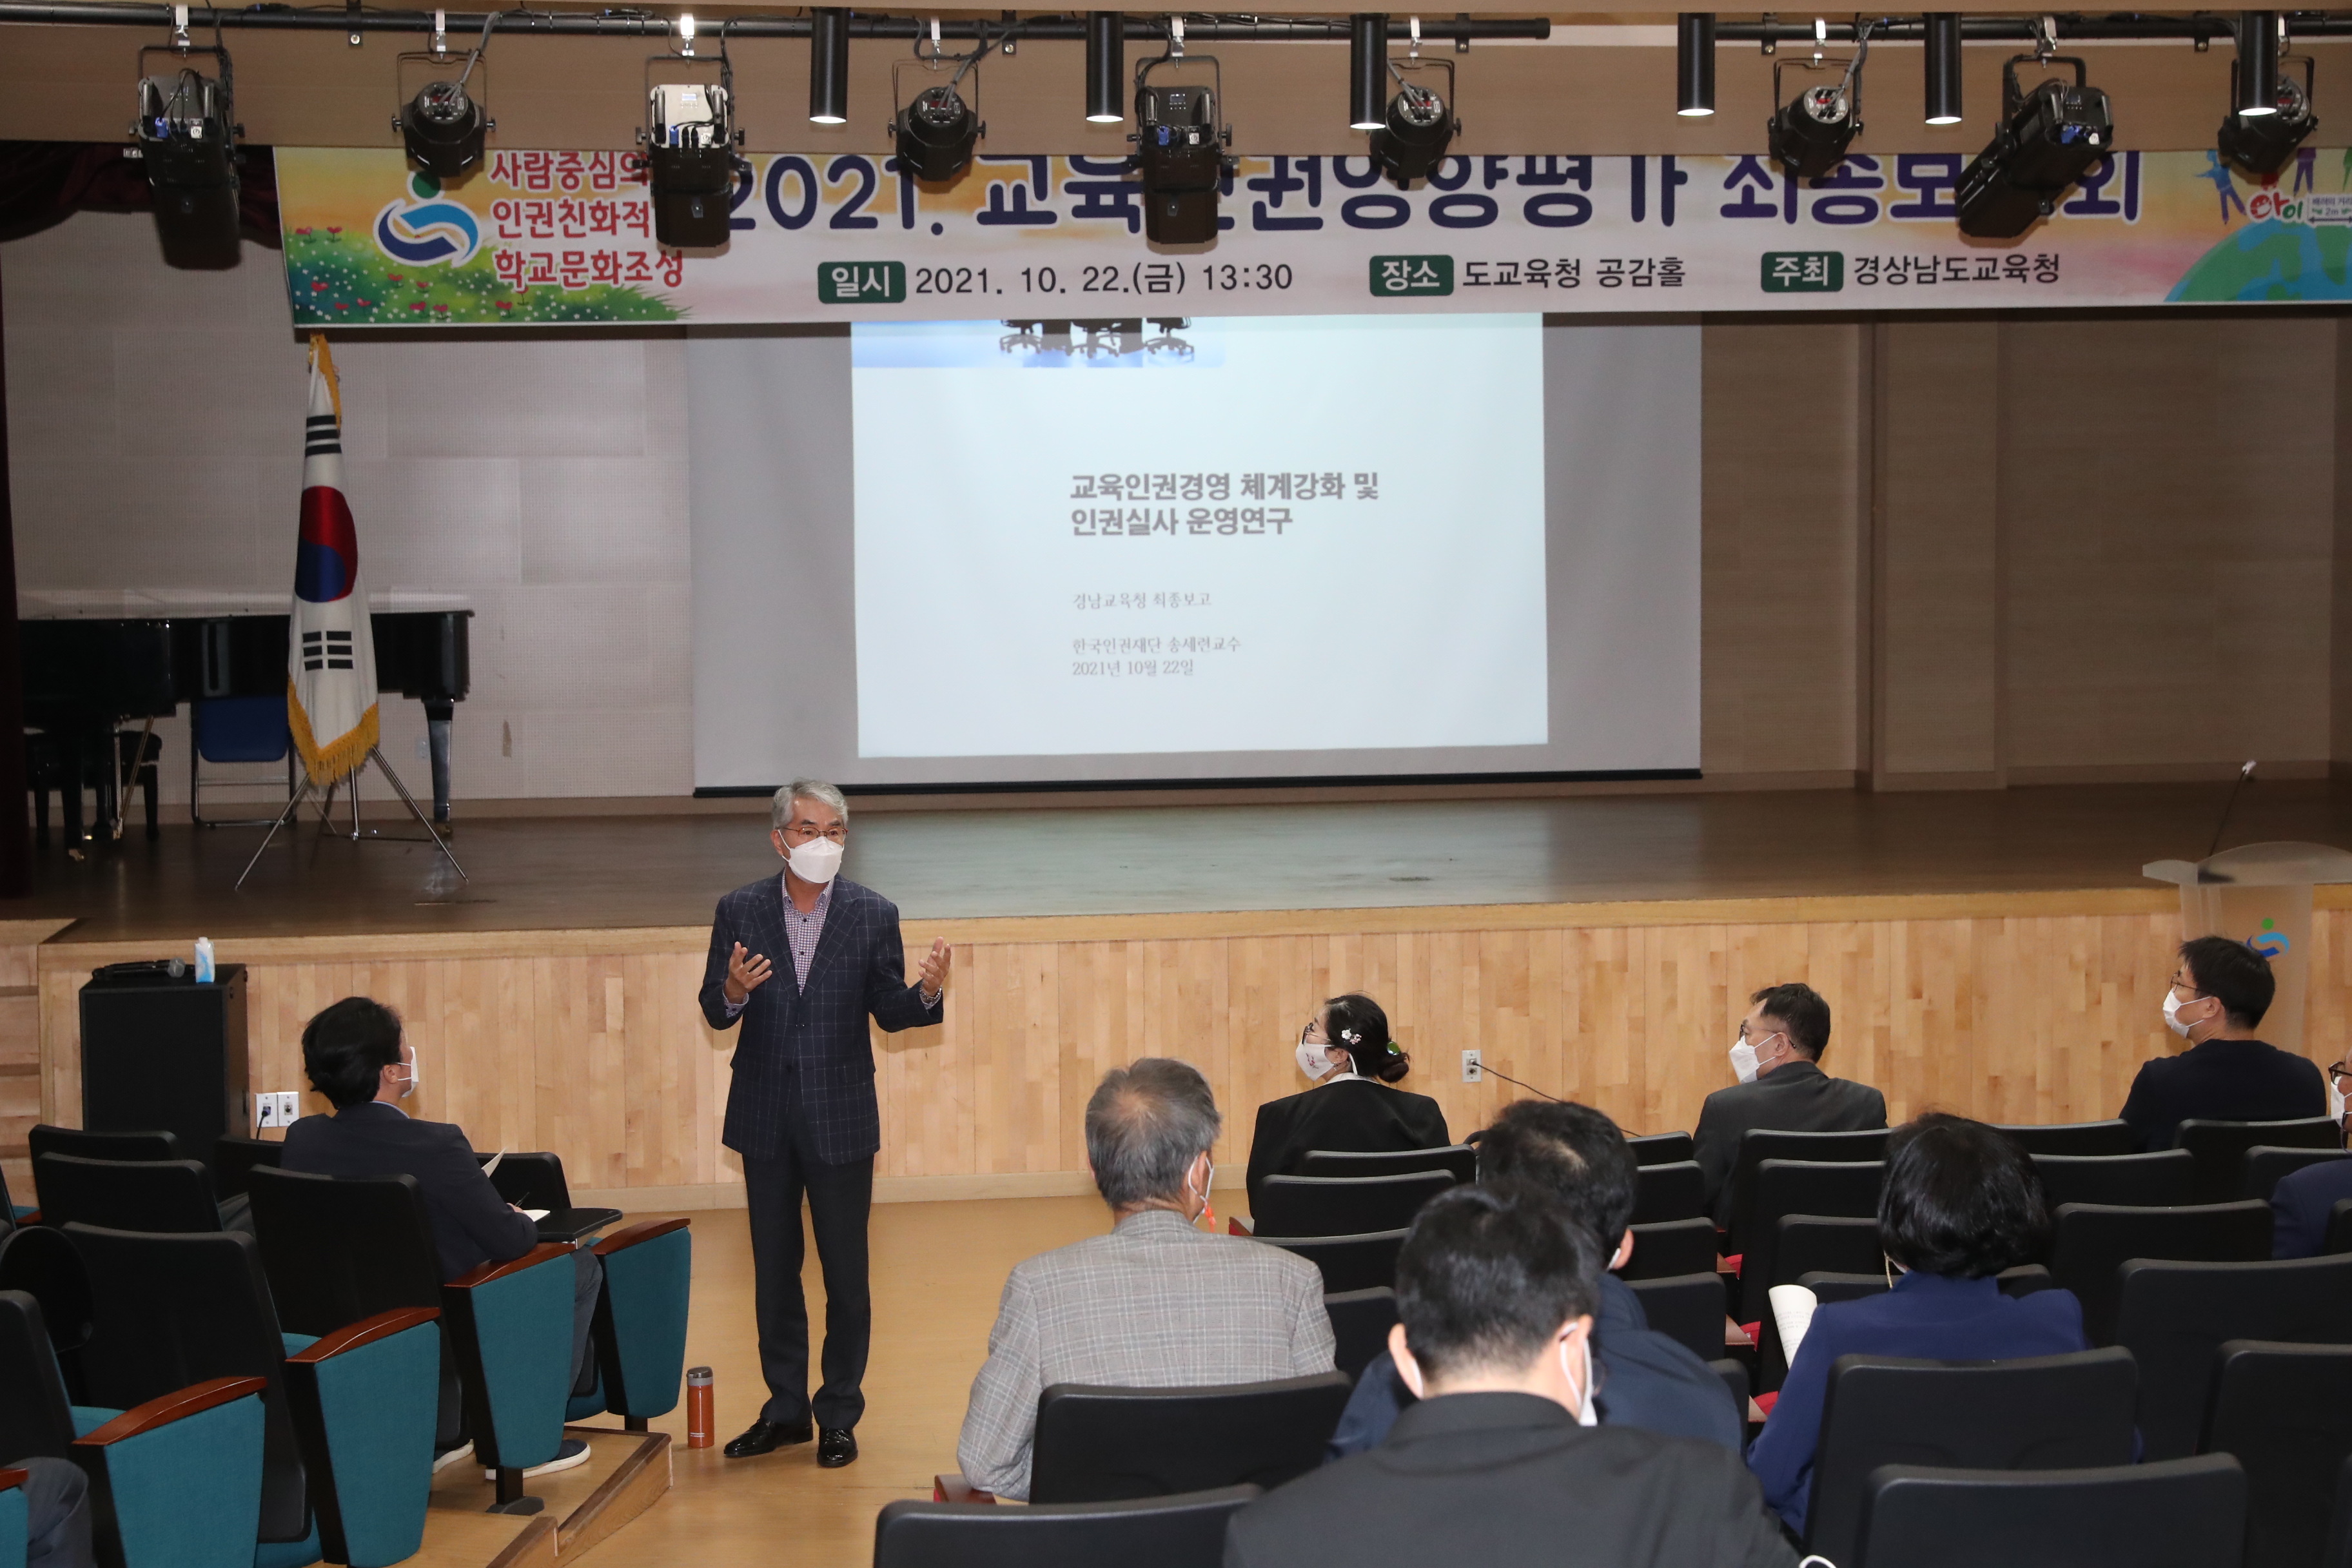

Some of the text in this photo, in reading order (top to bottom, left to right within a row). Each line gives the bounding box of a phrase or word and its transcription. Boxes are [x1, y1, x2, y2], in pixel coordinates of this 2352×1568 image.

[493, 199, 649, 239] 인권친화적
[495, 250, 683, 290] 학교문화조성
[832, 262, 1292, 297] 일시 2021. 10. 22.(금) 13:30
[1381, 257, 1685, 291] 장소 도교육청 공감홀
[1772, 254, 2059, 286] 주최 경상남도교육청
[1070, 473, 1379, 500] 교육인권경영 체계강화 및
[1071, 507, 1293, 536] 인권실사 운영연구
[1073, 592, 1211, 610] 경남교육청 최종보고
[1073, 637, 1161, 654] 한국인권재단
[1073, 659, 1193, 677] 2021년 10월 22일
